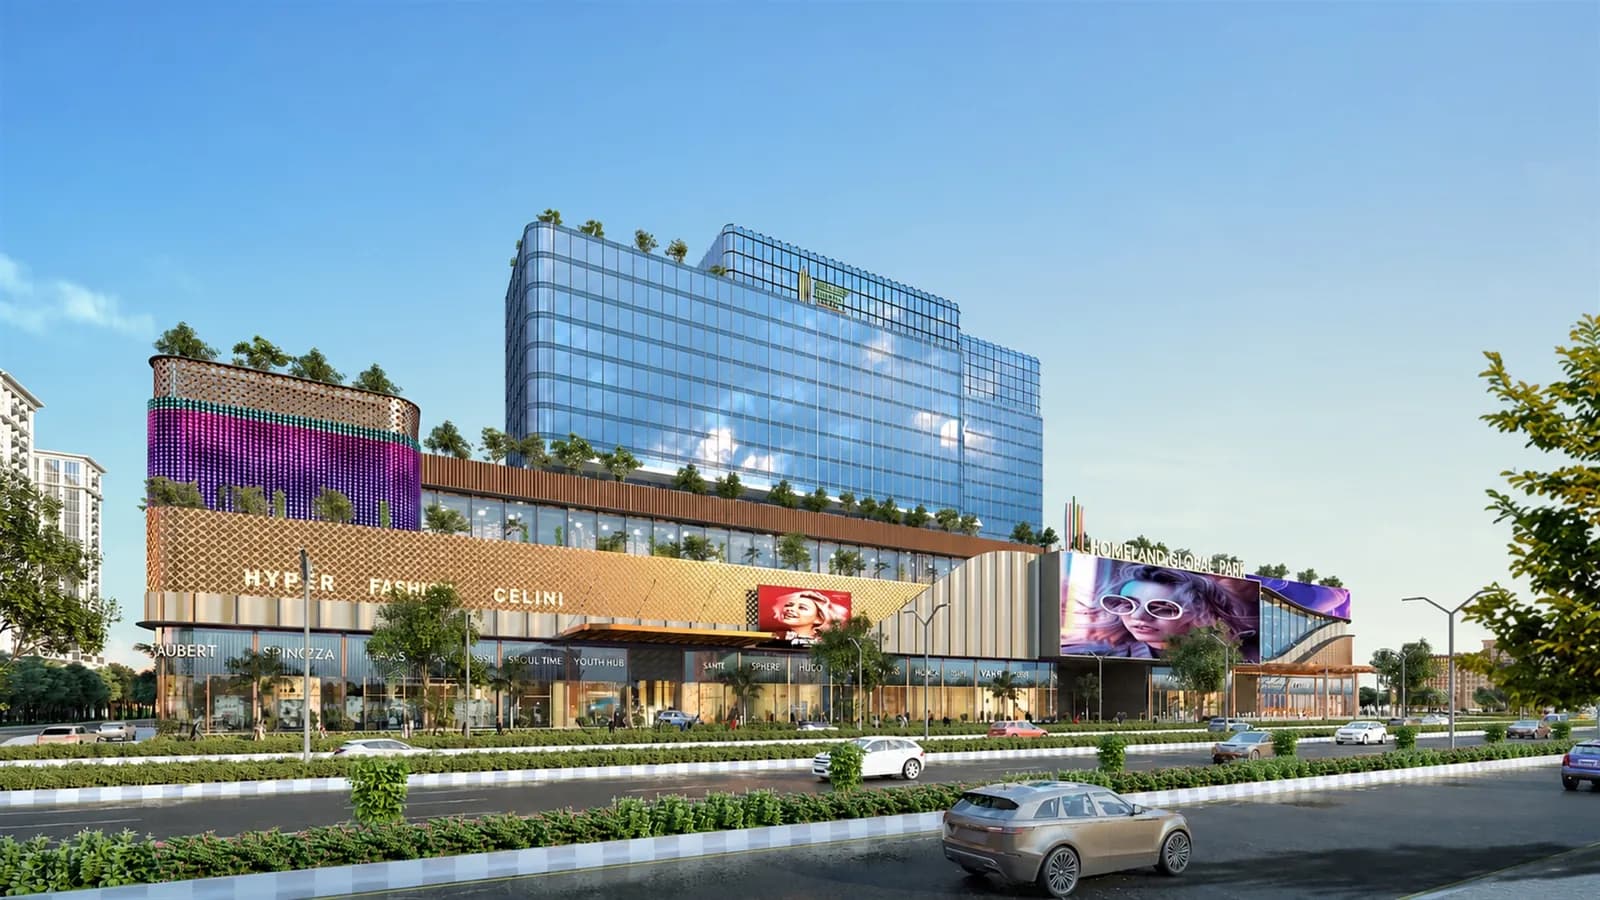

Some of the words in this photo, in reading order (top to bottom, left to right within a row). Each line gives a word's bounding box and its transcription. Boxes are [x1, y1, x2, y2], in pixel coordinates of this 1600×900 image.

[1091, 538, 1166, 567] HOMELAND
[1169, 552, 1214, 574] GLOBAL
[1219, 560, 1246, 579] PARK
[243, 568, 335, 591] HYPER
[493, 587, 564, 607] CELINI
[541, 656, 562, 665] TIME
[573, 657, 605, 666] YOUTH
[606, 658, 625, 667] HUB
[751, 661, 781, 671] SPHERE
